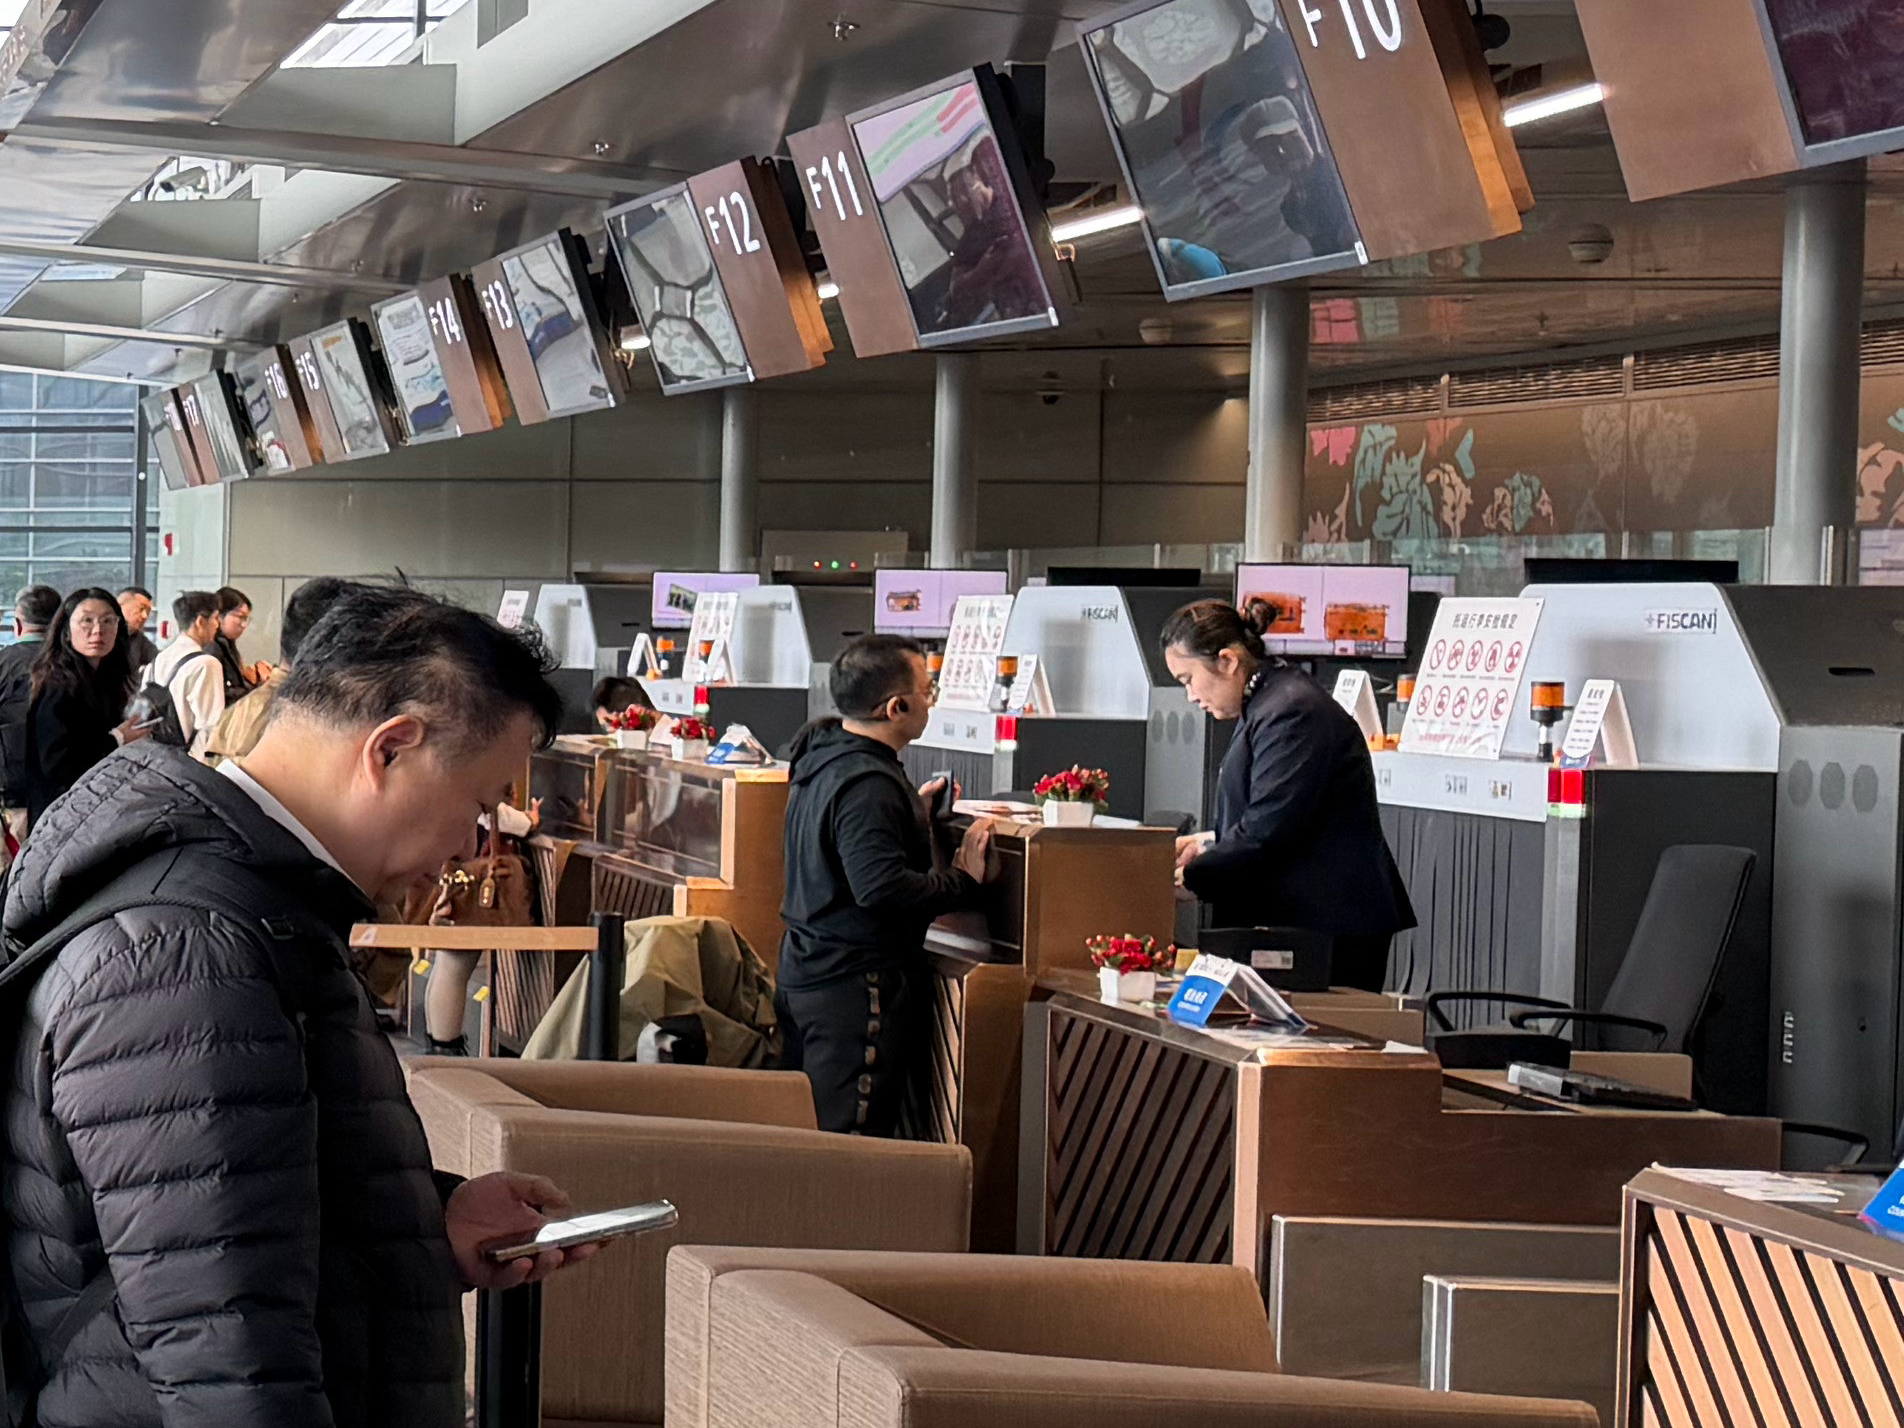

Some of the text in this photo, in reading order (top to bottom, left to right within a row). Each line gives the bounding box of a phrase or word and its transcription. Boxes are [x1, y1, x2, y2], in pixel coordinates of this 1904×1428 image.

[805, 149, 865, 221] F11
[704, 191, 762, 256] F12
[428, 296, 462, 345] F14
[480, 279, 516, 330] F13
[1656, 612, 1714, 630] FISCAN
